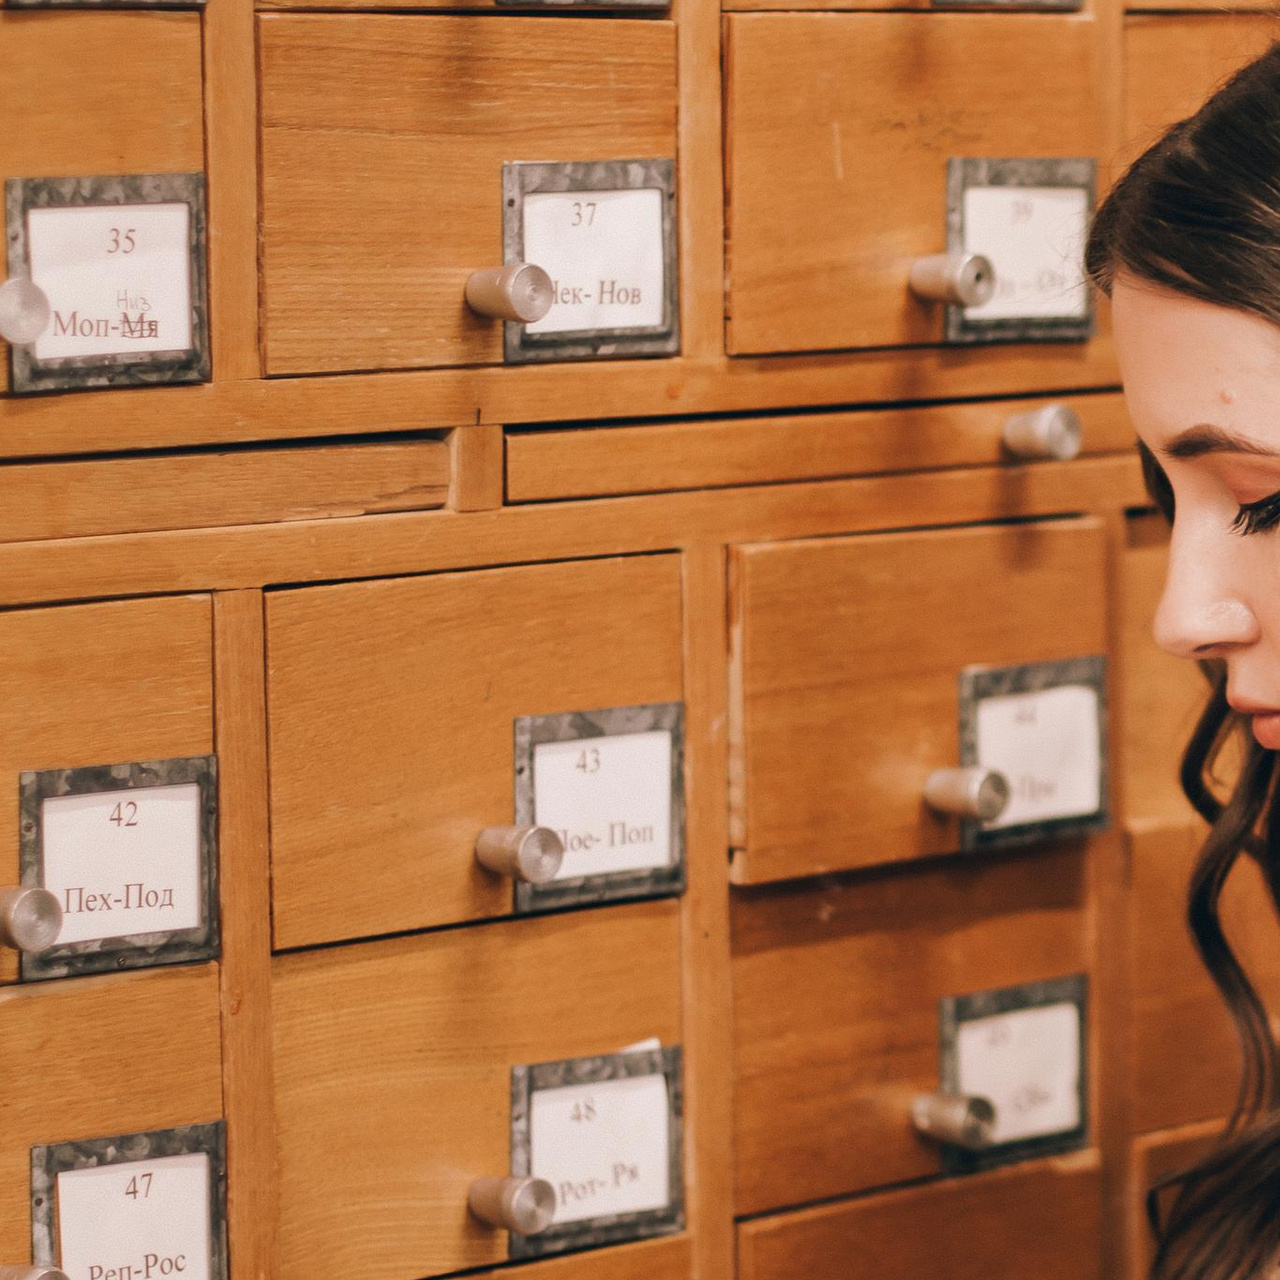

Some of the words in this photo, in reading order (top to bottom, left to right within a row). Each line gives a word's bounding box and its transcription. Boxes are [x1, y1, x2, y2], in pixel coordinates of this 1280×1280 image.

[571, 201, 598, 228] 37
[107, 227, 137, 255] 35
[116, 288, 152, 313] Низ
[599, 279, 643, 306] Нов
[575, 748, 601, 774] 43
[109, 800, 138, 827] 42
[608, 820, 655, 848] Поп
[64, 882, 175, 914] Пех-Под
[571, 1095, 598, 1124] 48
[125, 1172, 154, 1200] 47
